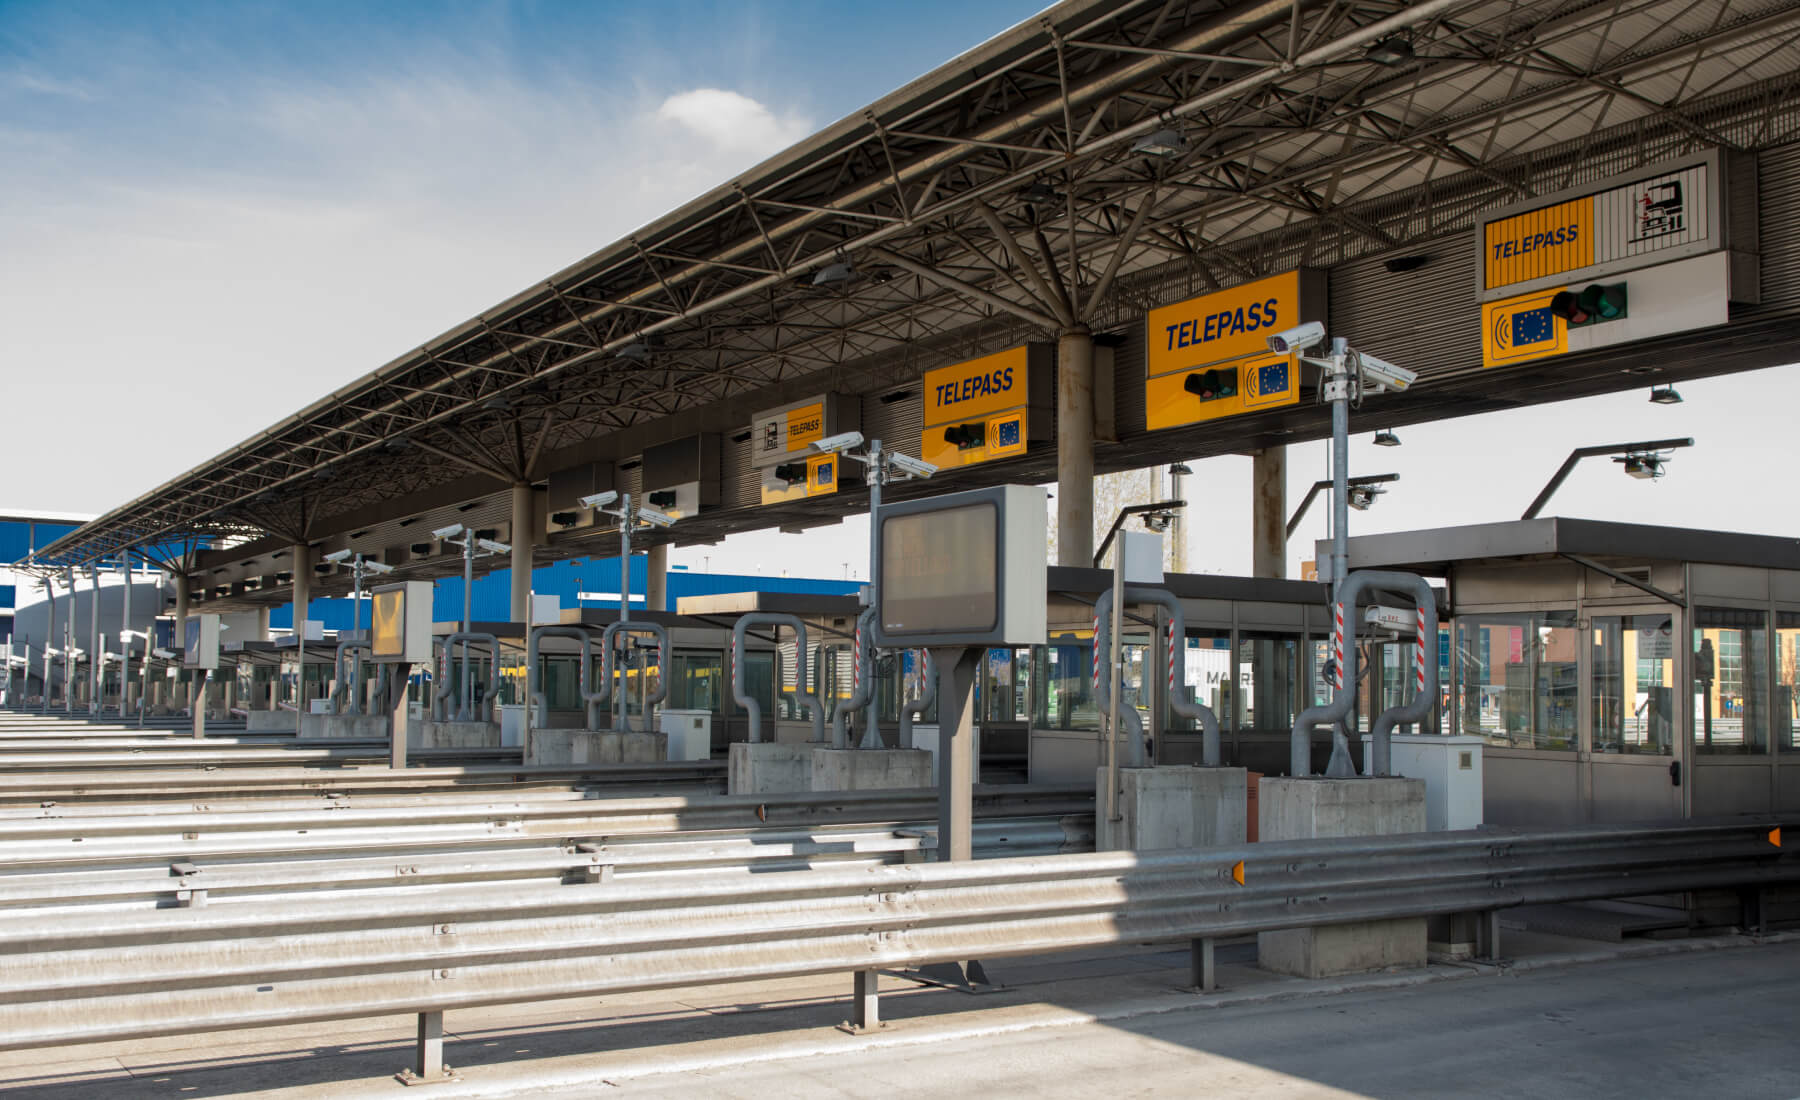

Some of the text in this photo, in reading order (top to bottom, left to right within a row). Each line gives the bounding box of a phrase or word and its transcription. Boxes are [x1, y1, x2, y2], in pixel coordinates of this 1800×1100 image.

[1494, 224, 1579, 261] TELEPASS
[1166, 298, 1278, 351] TELEPASS
[936, 367, 1014, 407] TELEPASS
[790, 419, 820, 437] TELEPASS
